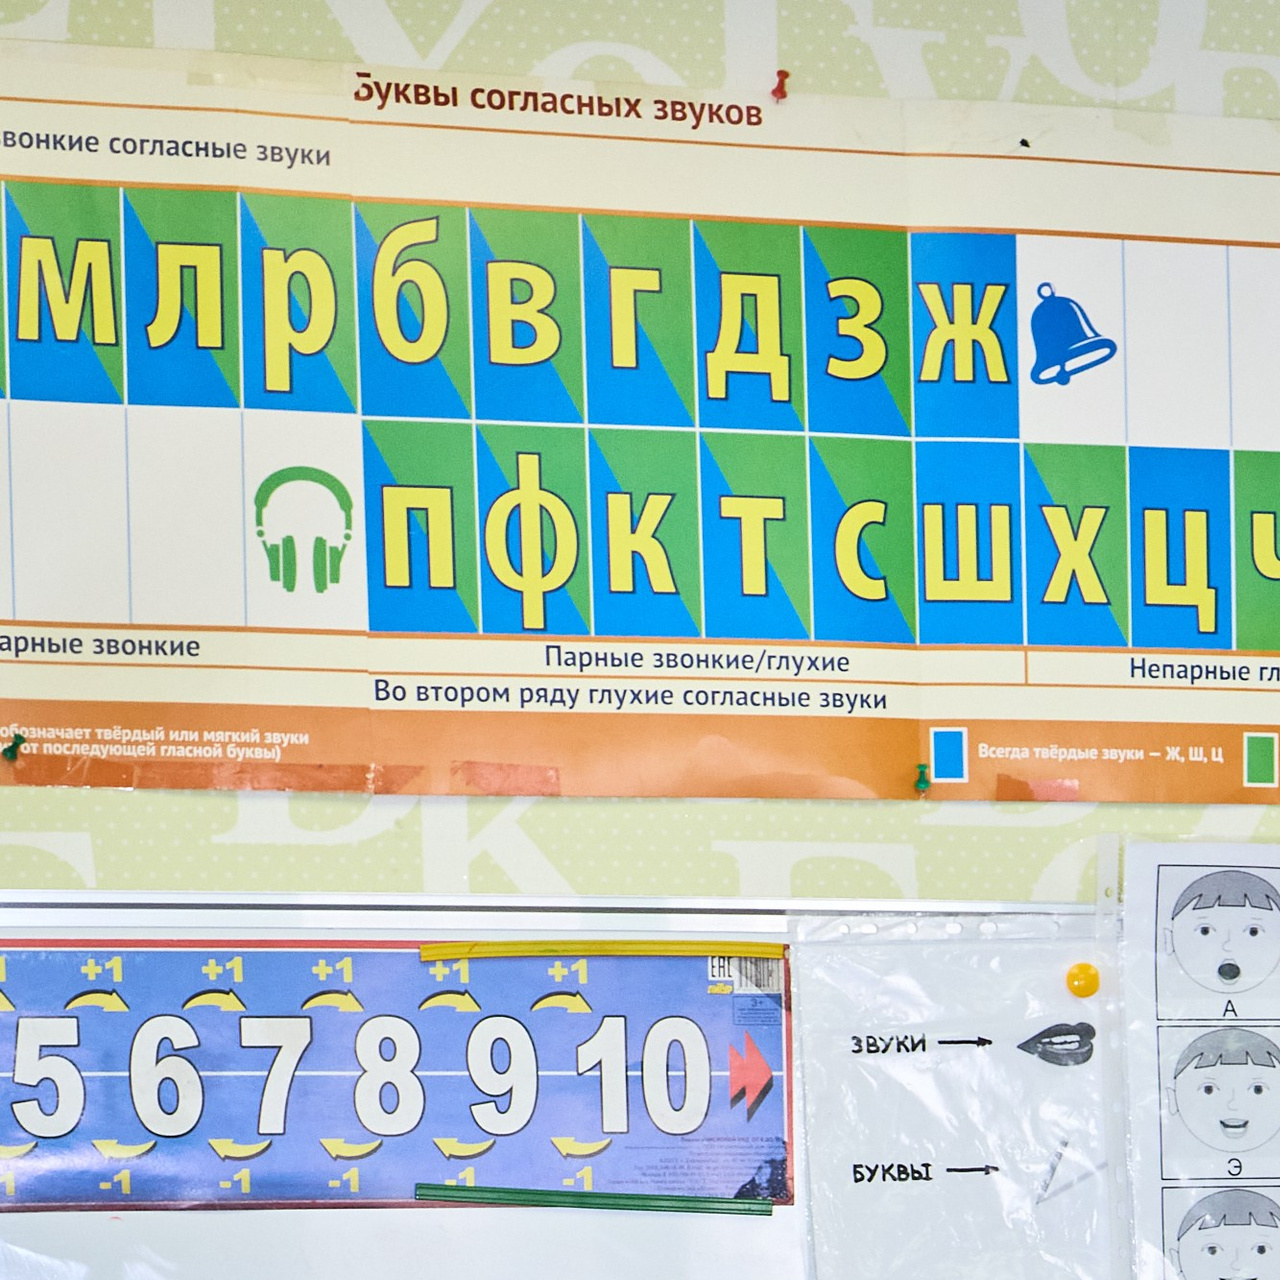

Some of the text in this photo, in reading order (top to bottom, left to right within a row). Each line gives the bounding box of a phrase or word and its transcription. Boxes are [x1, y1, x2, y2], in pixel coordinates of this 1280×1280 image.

[354, 72, 763, 129] Буквы согласных звуков
[0, 129, 331, 169] вонкие согласные звуки
[92, 637, 201, 657] звонкие
[545, 644, 850, 674] Парные звонкие/глухие
[1129, 657, 1251, 683] Непарные
[374, 679, 887, 712] Во втором ряду глухие согласные звуки
[0, 723, 309, 746] обозначает твёрдый или мягкий звуки
[20, 743, 39, 754] от
[42, 741, 156, 757] последующей
[160, 743, 221, 758] гласной
[226, 744, 282, 761] буквы)
[978, 743, 1224, 765] Всегда твёрдые звуки Ж, Ш, Ц
[81, 956, 123, 982] +1
[202, 956, 244, 982] +1
[312, 957, 353, 983] +1
[429, 958, 470, 984] +1
[548, 959, 588, 984] +1
[1222, 999, 1238, 1018] А
[851, 1033, 926, 1054] ЗВУКИ
[12, 1014, 712, 1138] 5 6 7 8 9 10
[329, 1167, 359, 1192] -1
[445, 1167, 475, 1187] -1
[562, 1166, 593, 1191] -1
[852, 1162, 933, 1184] БУКВЫ
[1227, 1157, 1243, 1177] Э
[100, 1169, 131, 1194] -1
[219, 1168, 250, 1193] -1
